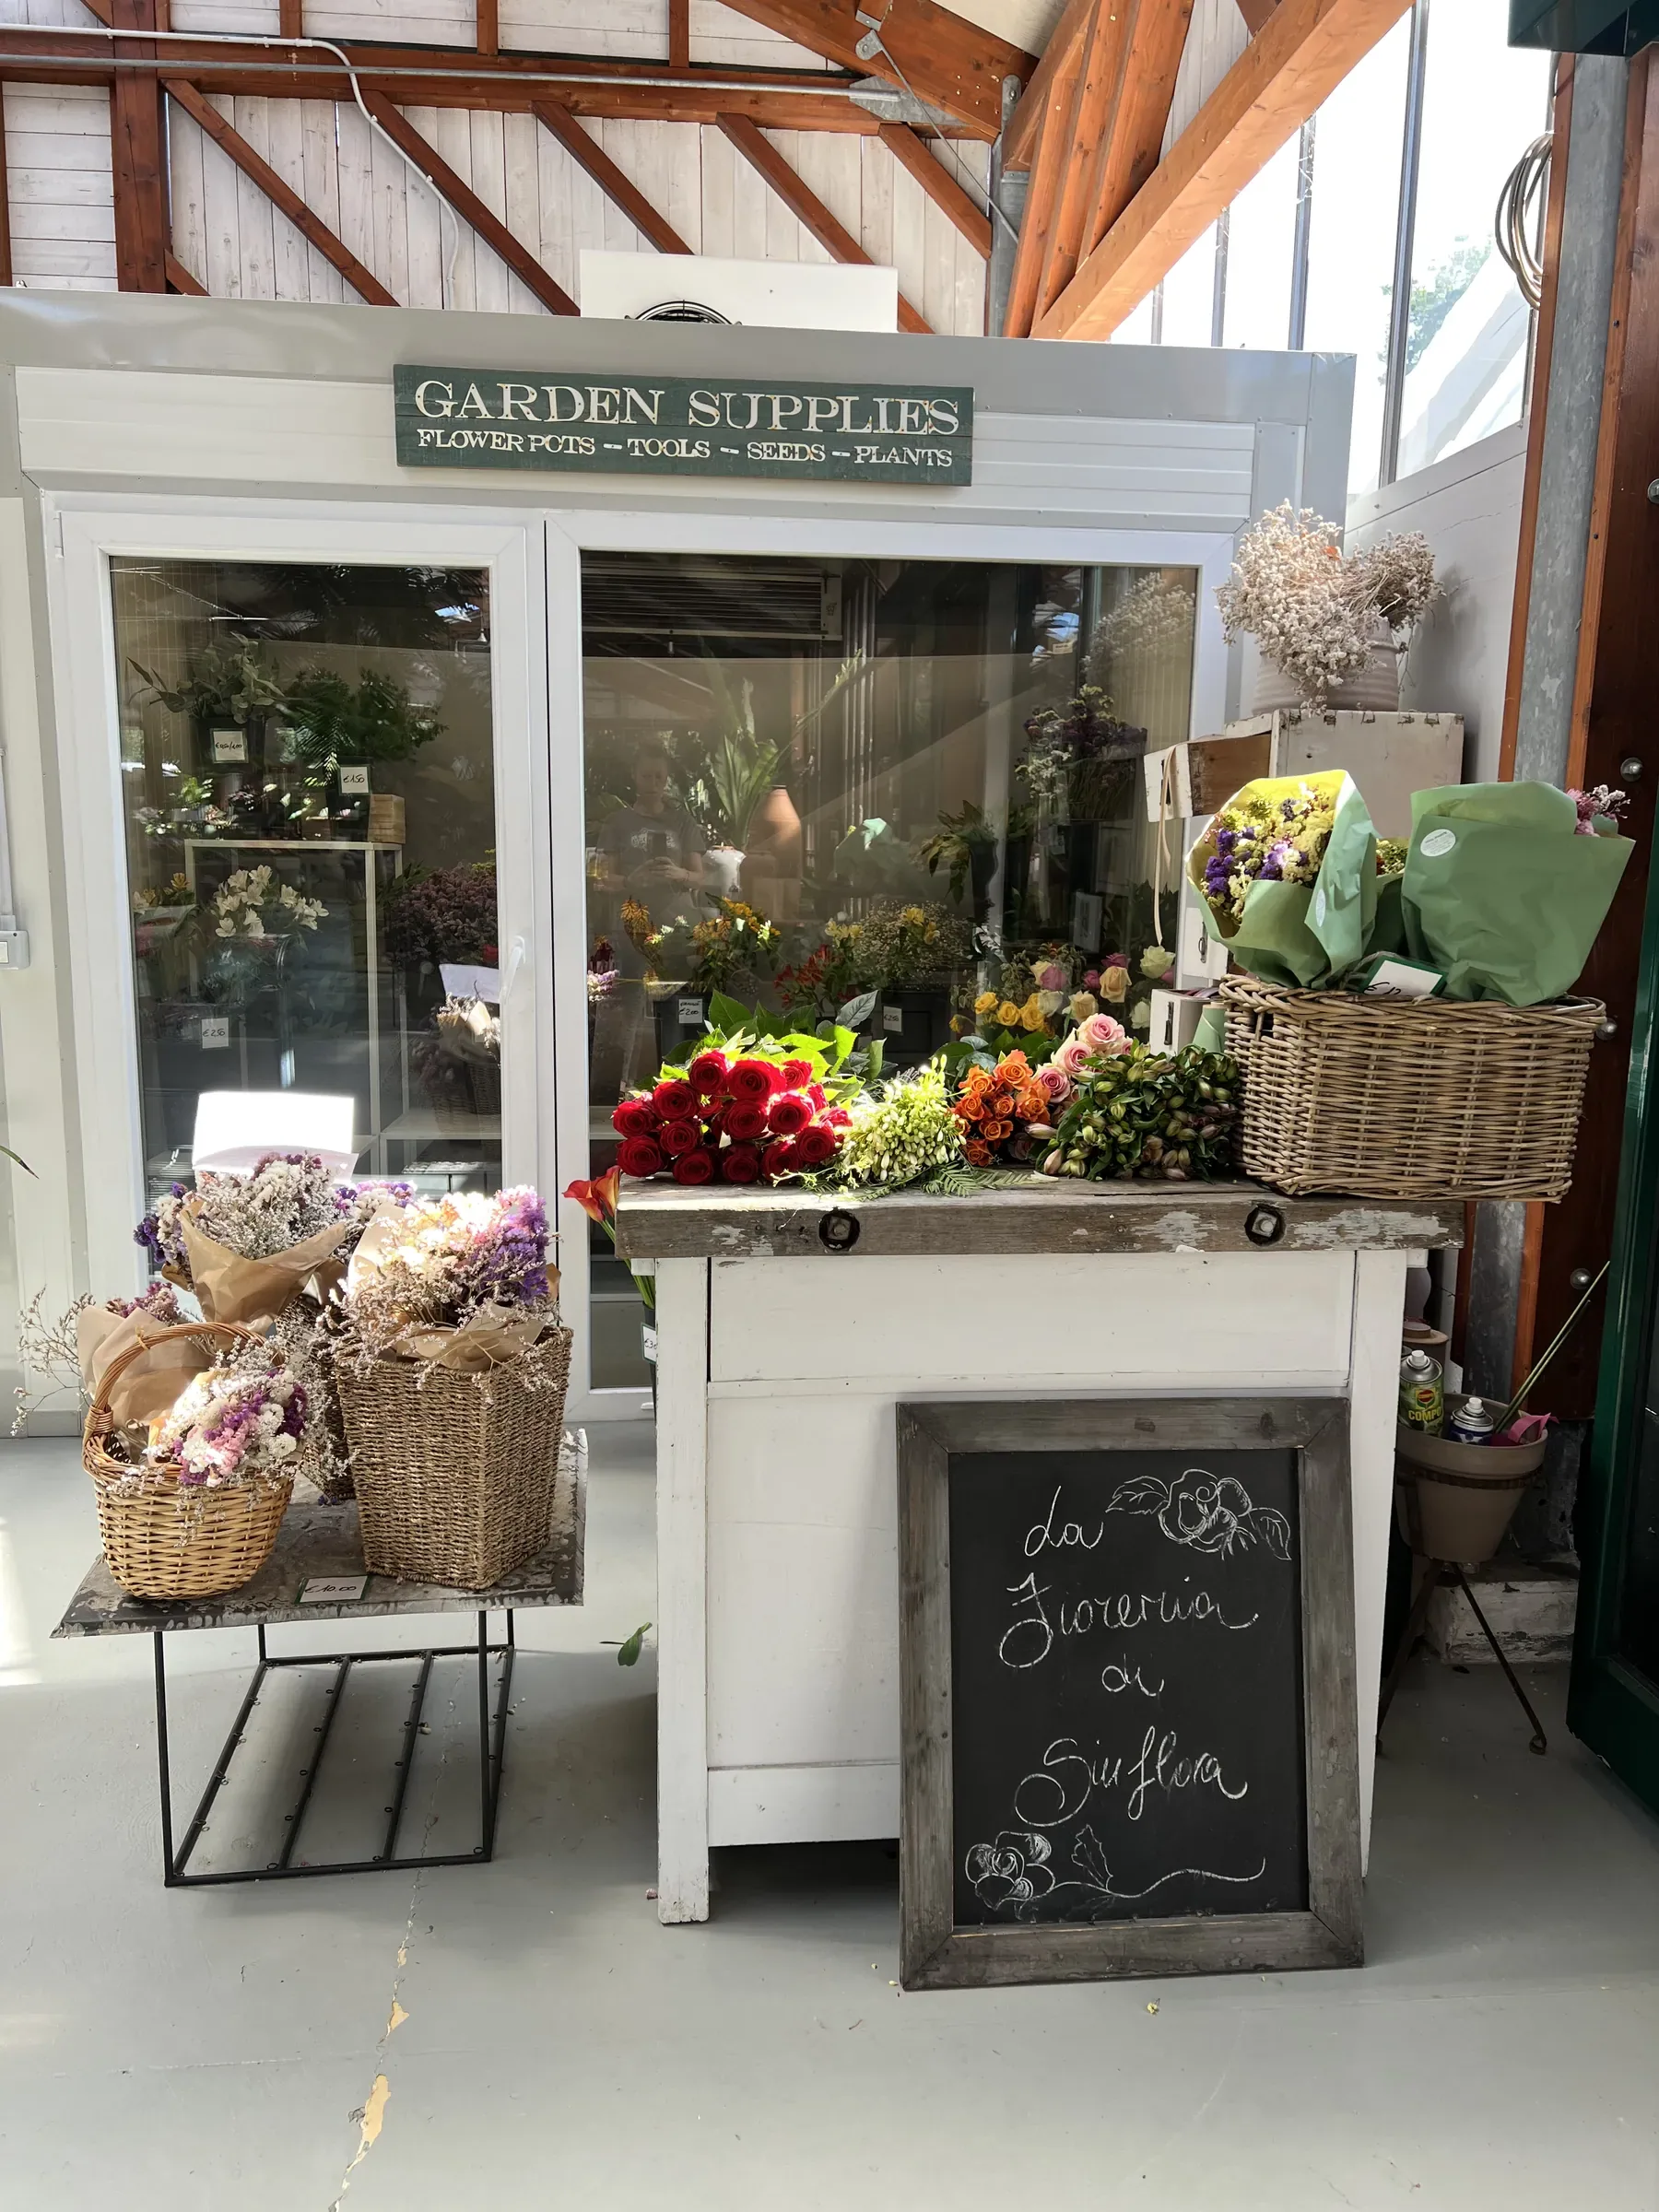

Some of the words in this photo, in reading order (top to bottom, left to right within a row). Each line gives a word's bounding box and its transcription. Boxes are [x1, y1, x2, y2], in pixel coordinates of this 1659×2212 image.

[415, 380, 665, 425] GARDEN
[688, 390, 959, 435] SUPPLIES
[627, 438, 711, 459] TOOLS
[747, 441, 826, 462] SEEDS
[853, 445, 953, 467] PLANTS
[1408, 1406, 1442, 1421] COMPO
